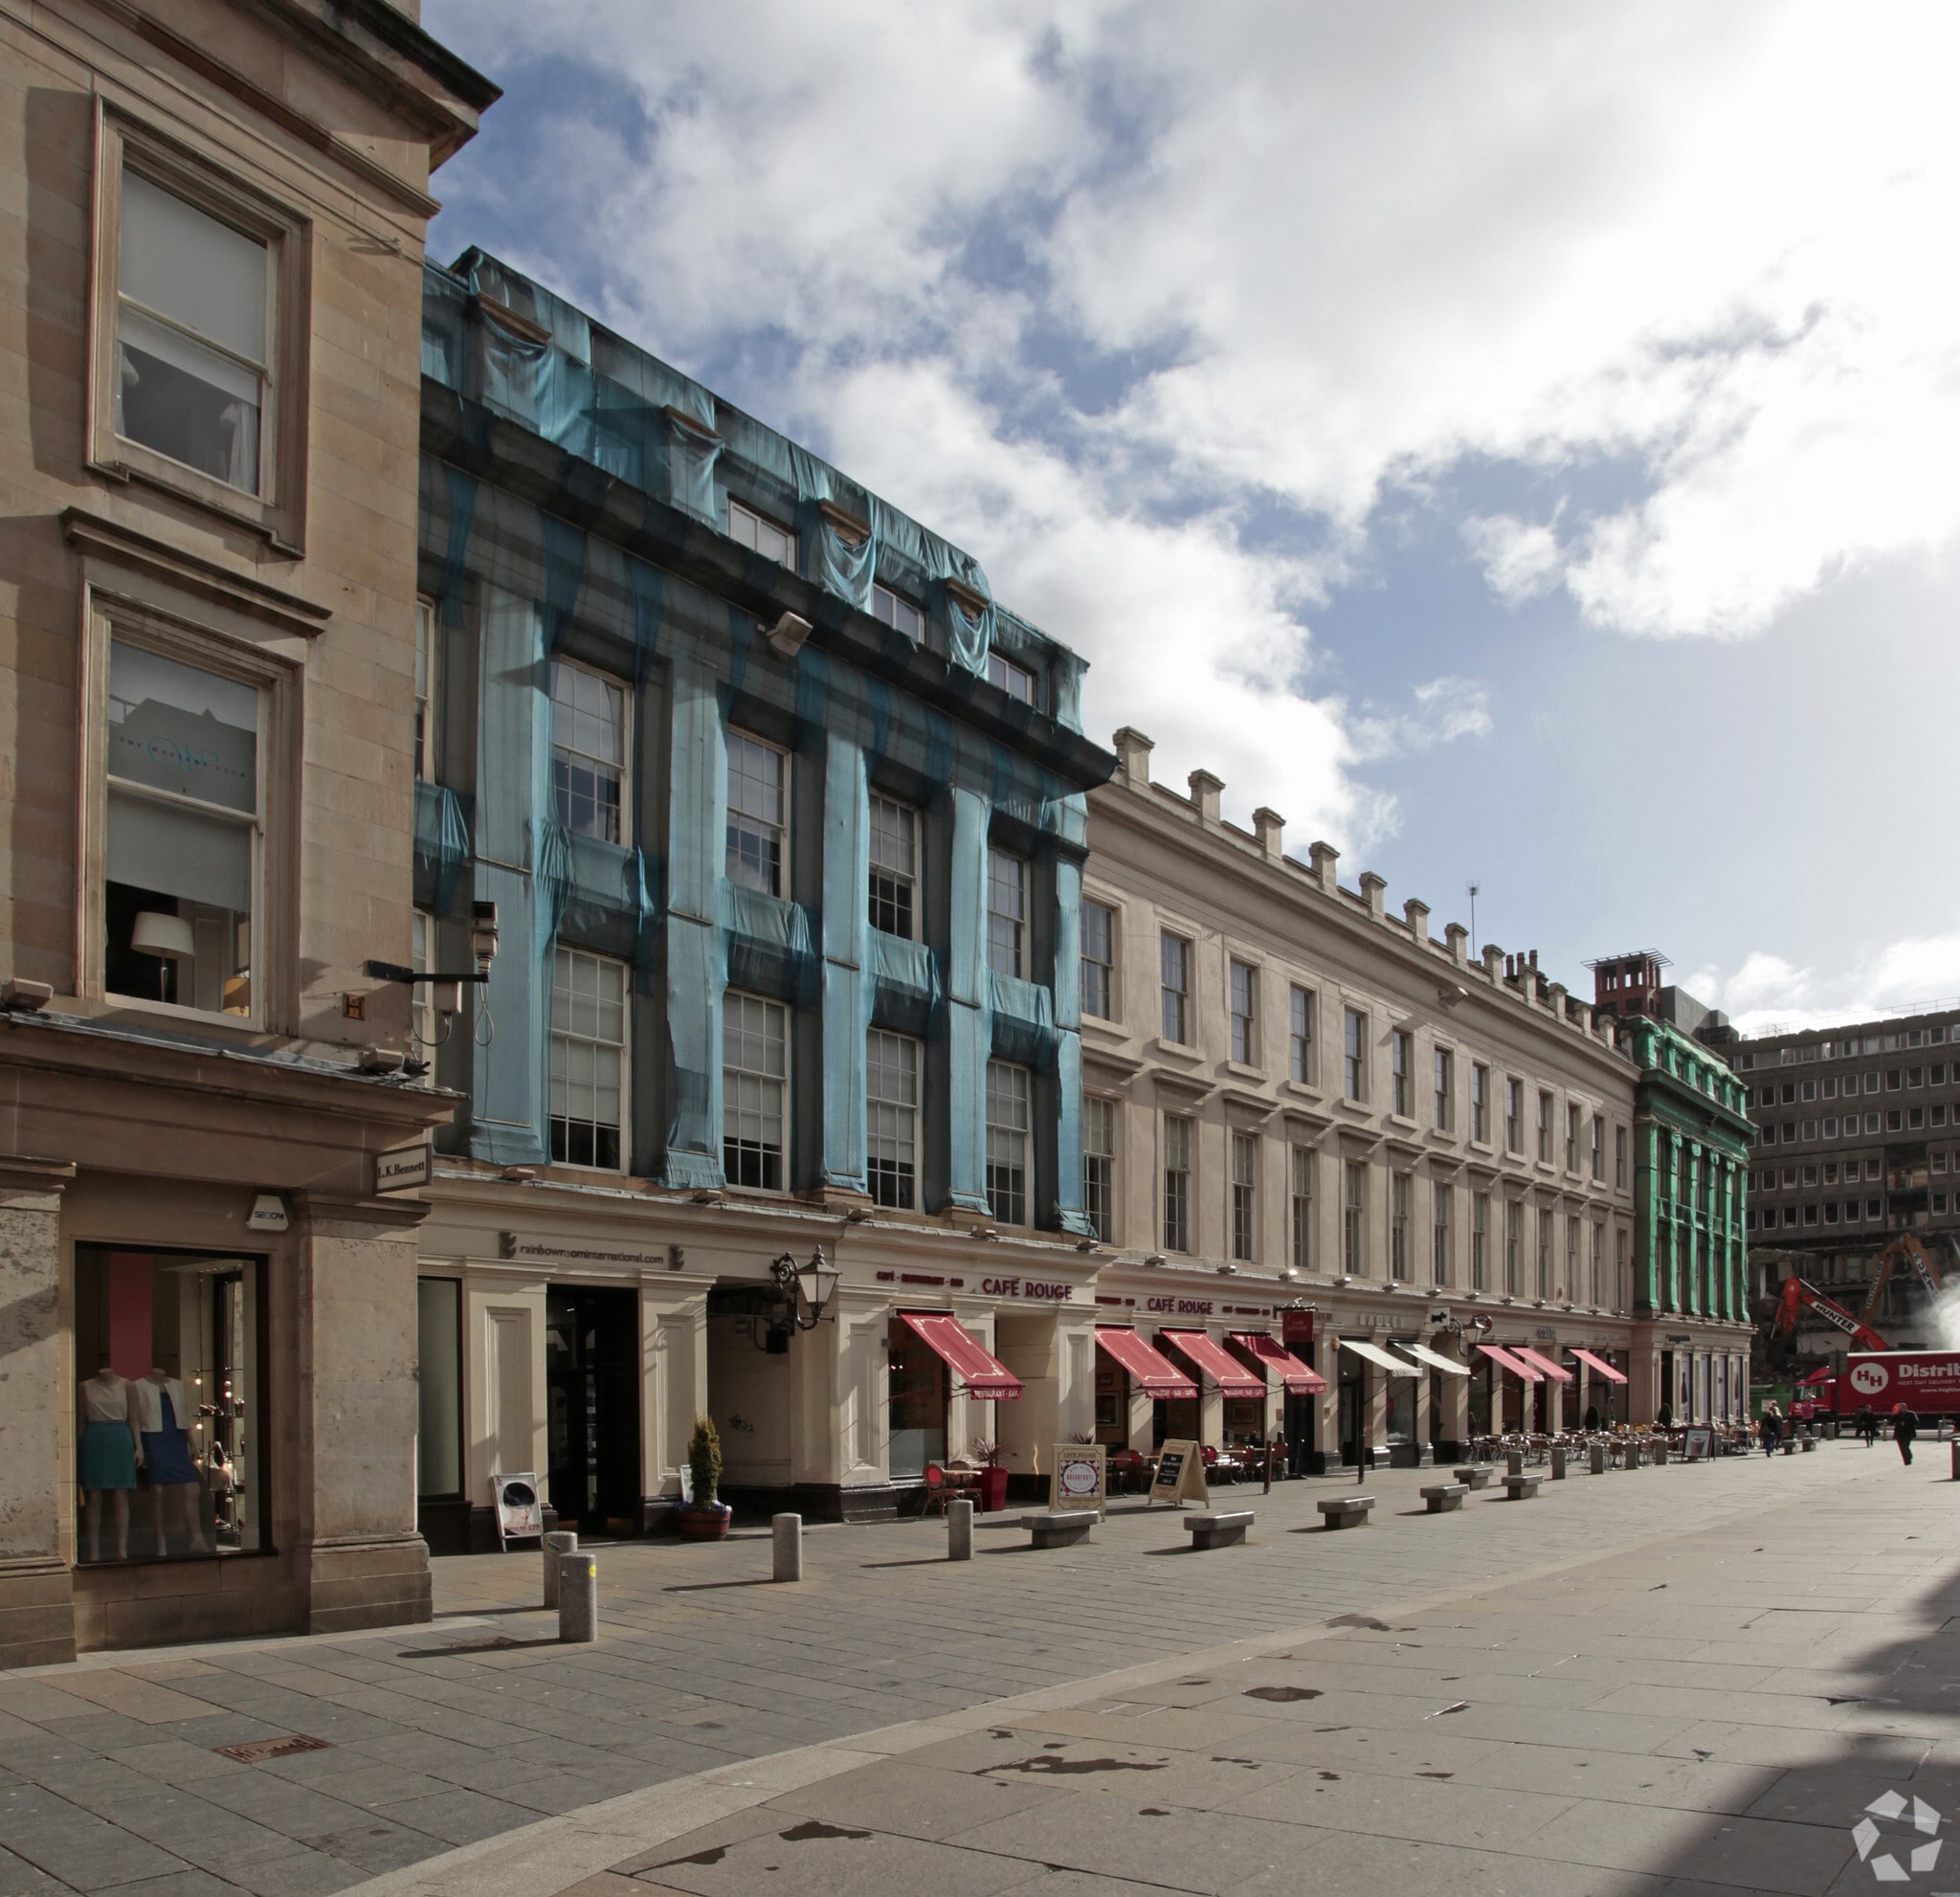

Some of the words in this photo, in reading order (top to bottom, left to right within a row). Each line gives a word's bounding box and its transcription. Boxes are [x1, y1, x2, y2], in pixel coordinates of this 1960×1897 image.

[254, 1211, 285, 1220] SECOM
[520, 1244, 664, 1263] rainbowroominternational.com
[982, 1278, 1021, 1297] CAFÉ
[1025, 1282, 1072, 1300] ROUGE
[1147, 1296, 1175, 1312] CAFÉ
[1178, 1300, 1213, 1315] ROUGE
[1815, 1303, 1856, 1331] HUNTER
